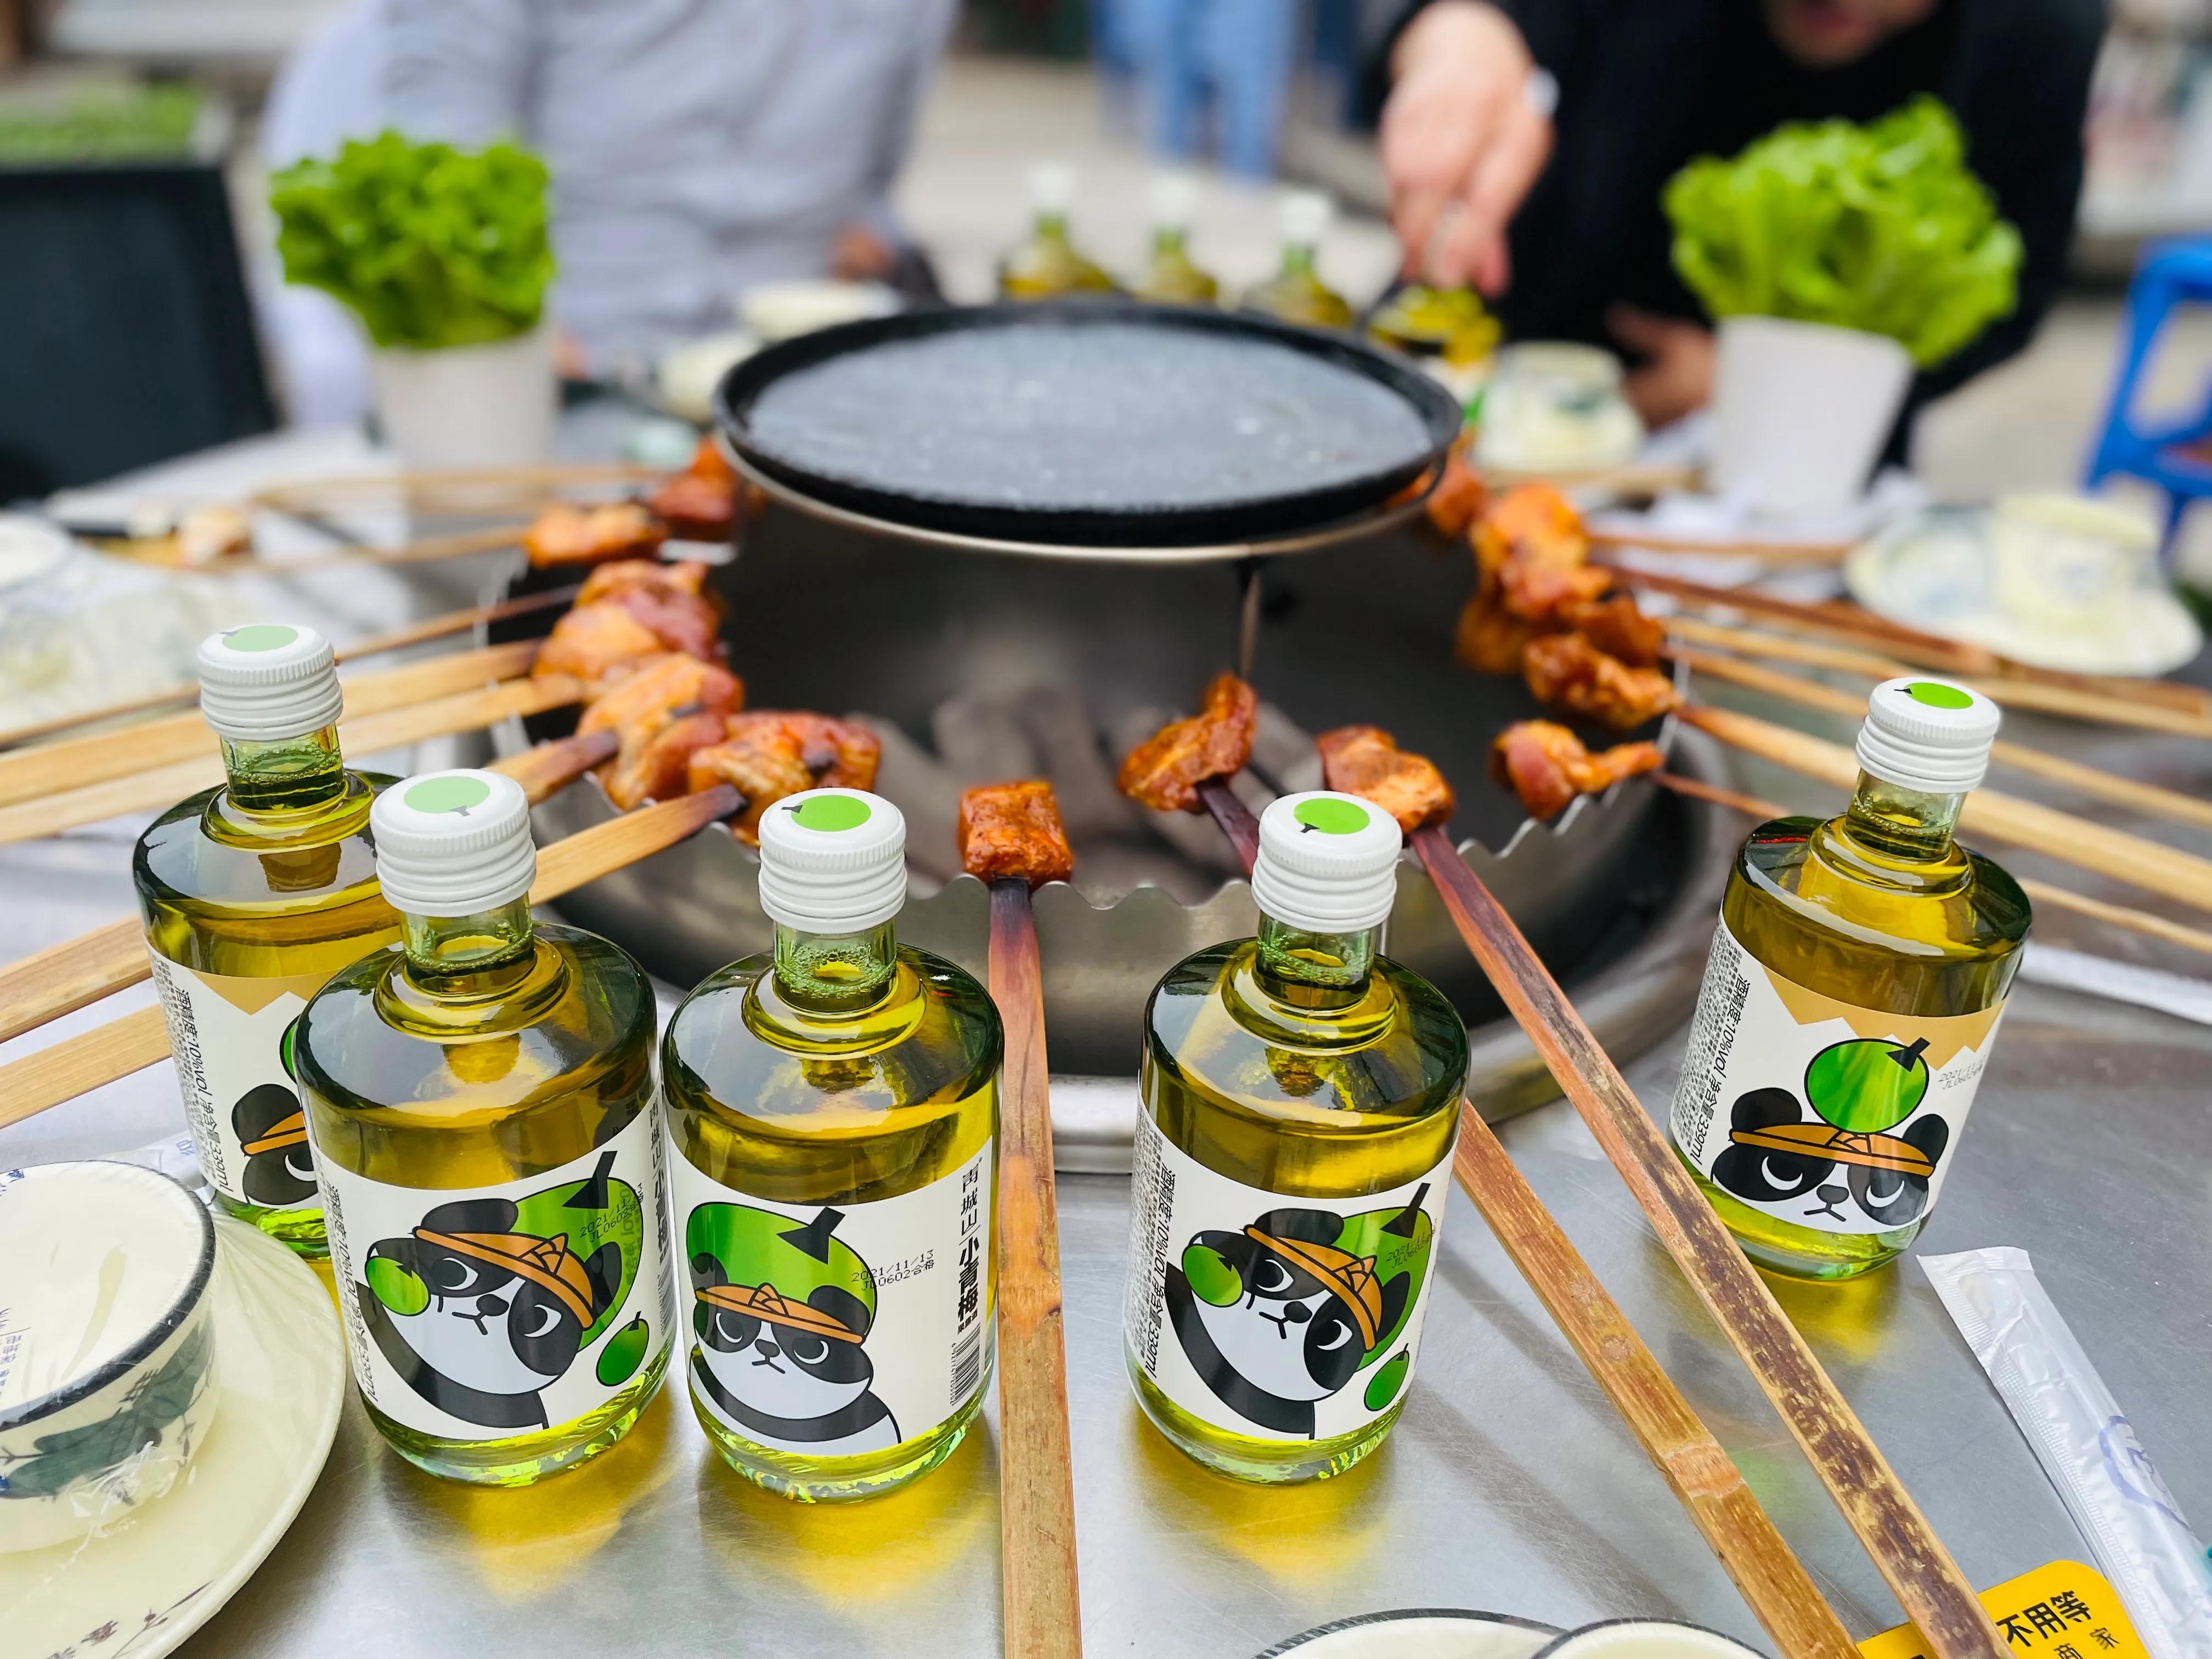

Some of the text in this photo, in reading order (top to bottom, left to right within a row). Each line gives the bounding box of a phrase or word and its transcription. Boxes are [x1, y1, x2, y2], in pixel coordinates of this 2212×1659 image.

[174, 985, 212, 1097] 酒精度:10%vol
[1713, 973, 1751, 1079] 酒精度:10%vol
[851, 1249, 934, 1283] 2021/11/13
[958, 1162, 980, 1323] 青城山 小青梅
[1153, 1162, 1176, 1280] 酒精度:10%vol
[1996, 1589, 2092, 1647] 不用等
